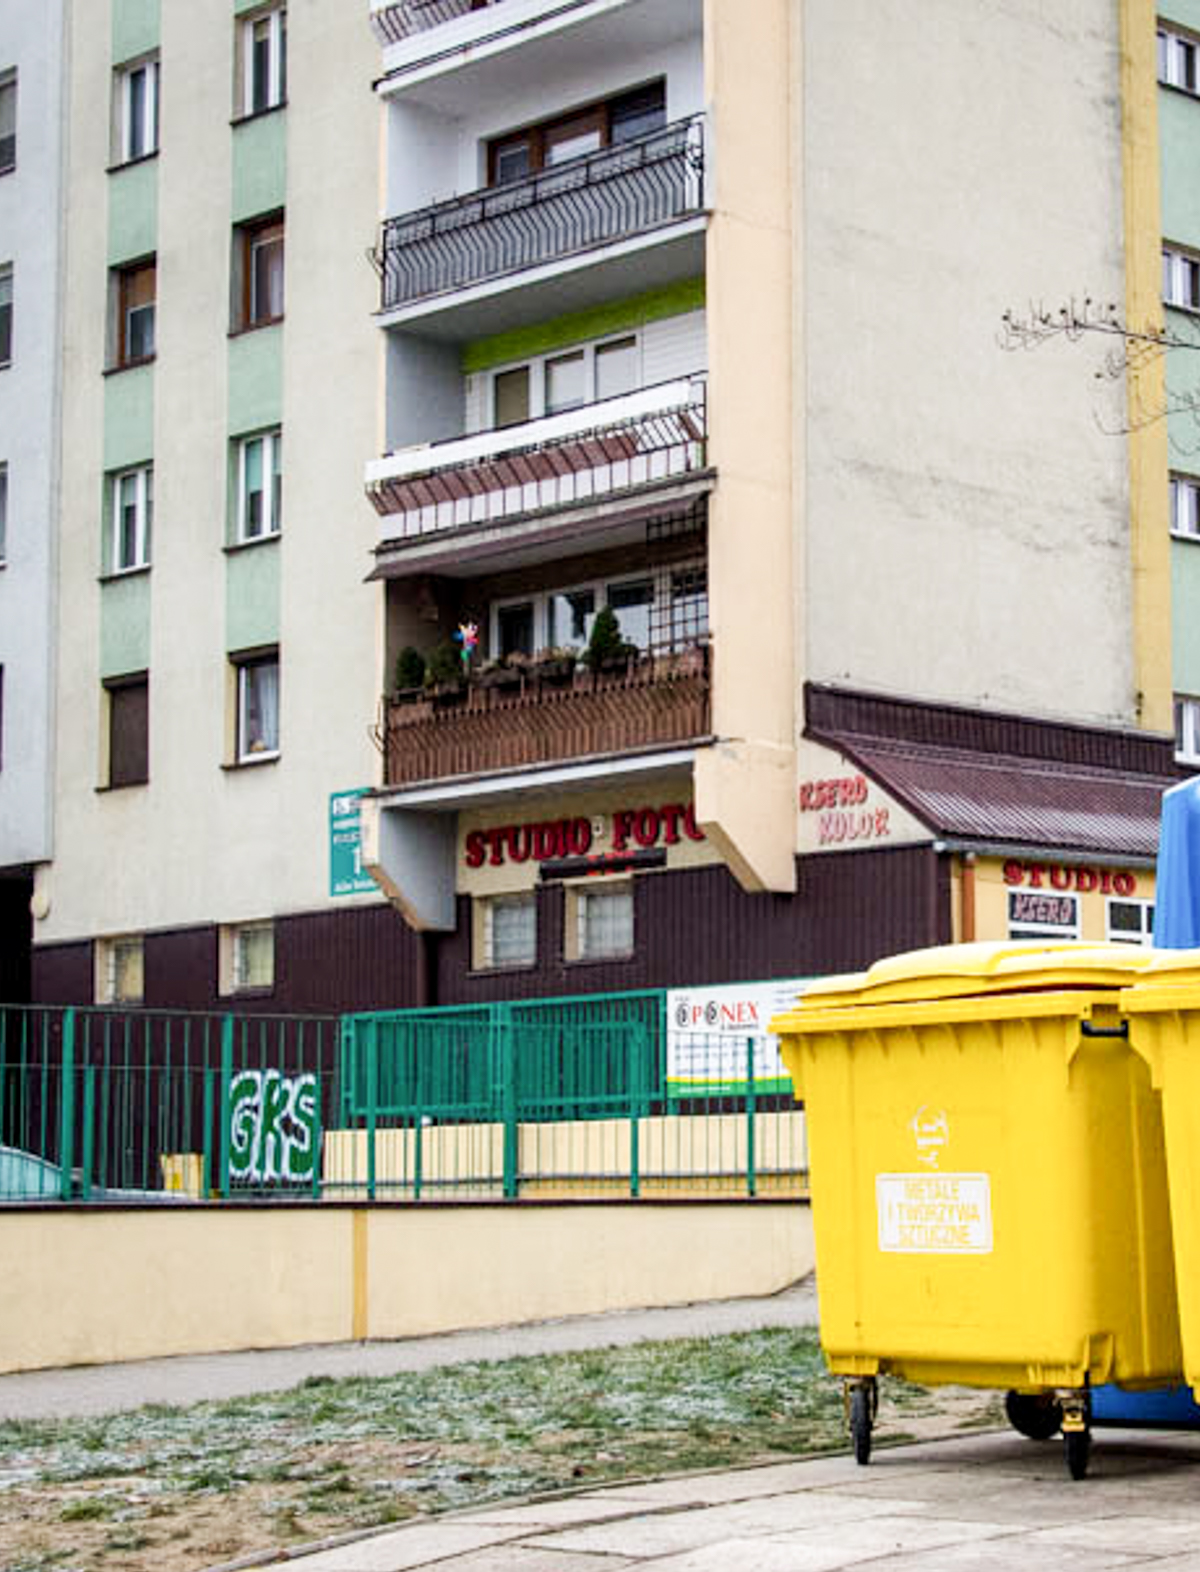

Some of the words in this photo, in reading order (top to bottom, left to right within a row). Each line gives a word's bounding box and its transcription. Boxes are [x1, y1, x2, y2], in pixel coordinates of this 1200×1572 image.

[800, 774, 868, 812] KSERO
[465, 817, 592, 867] STUDIO
[1003, 858, 1136, 897] STUDIO
